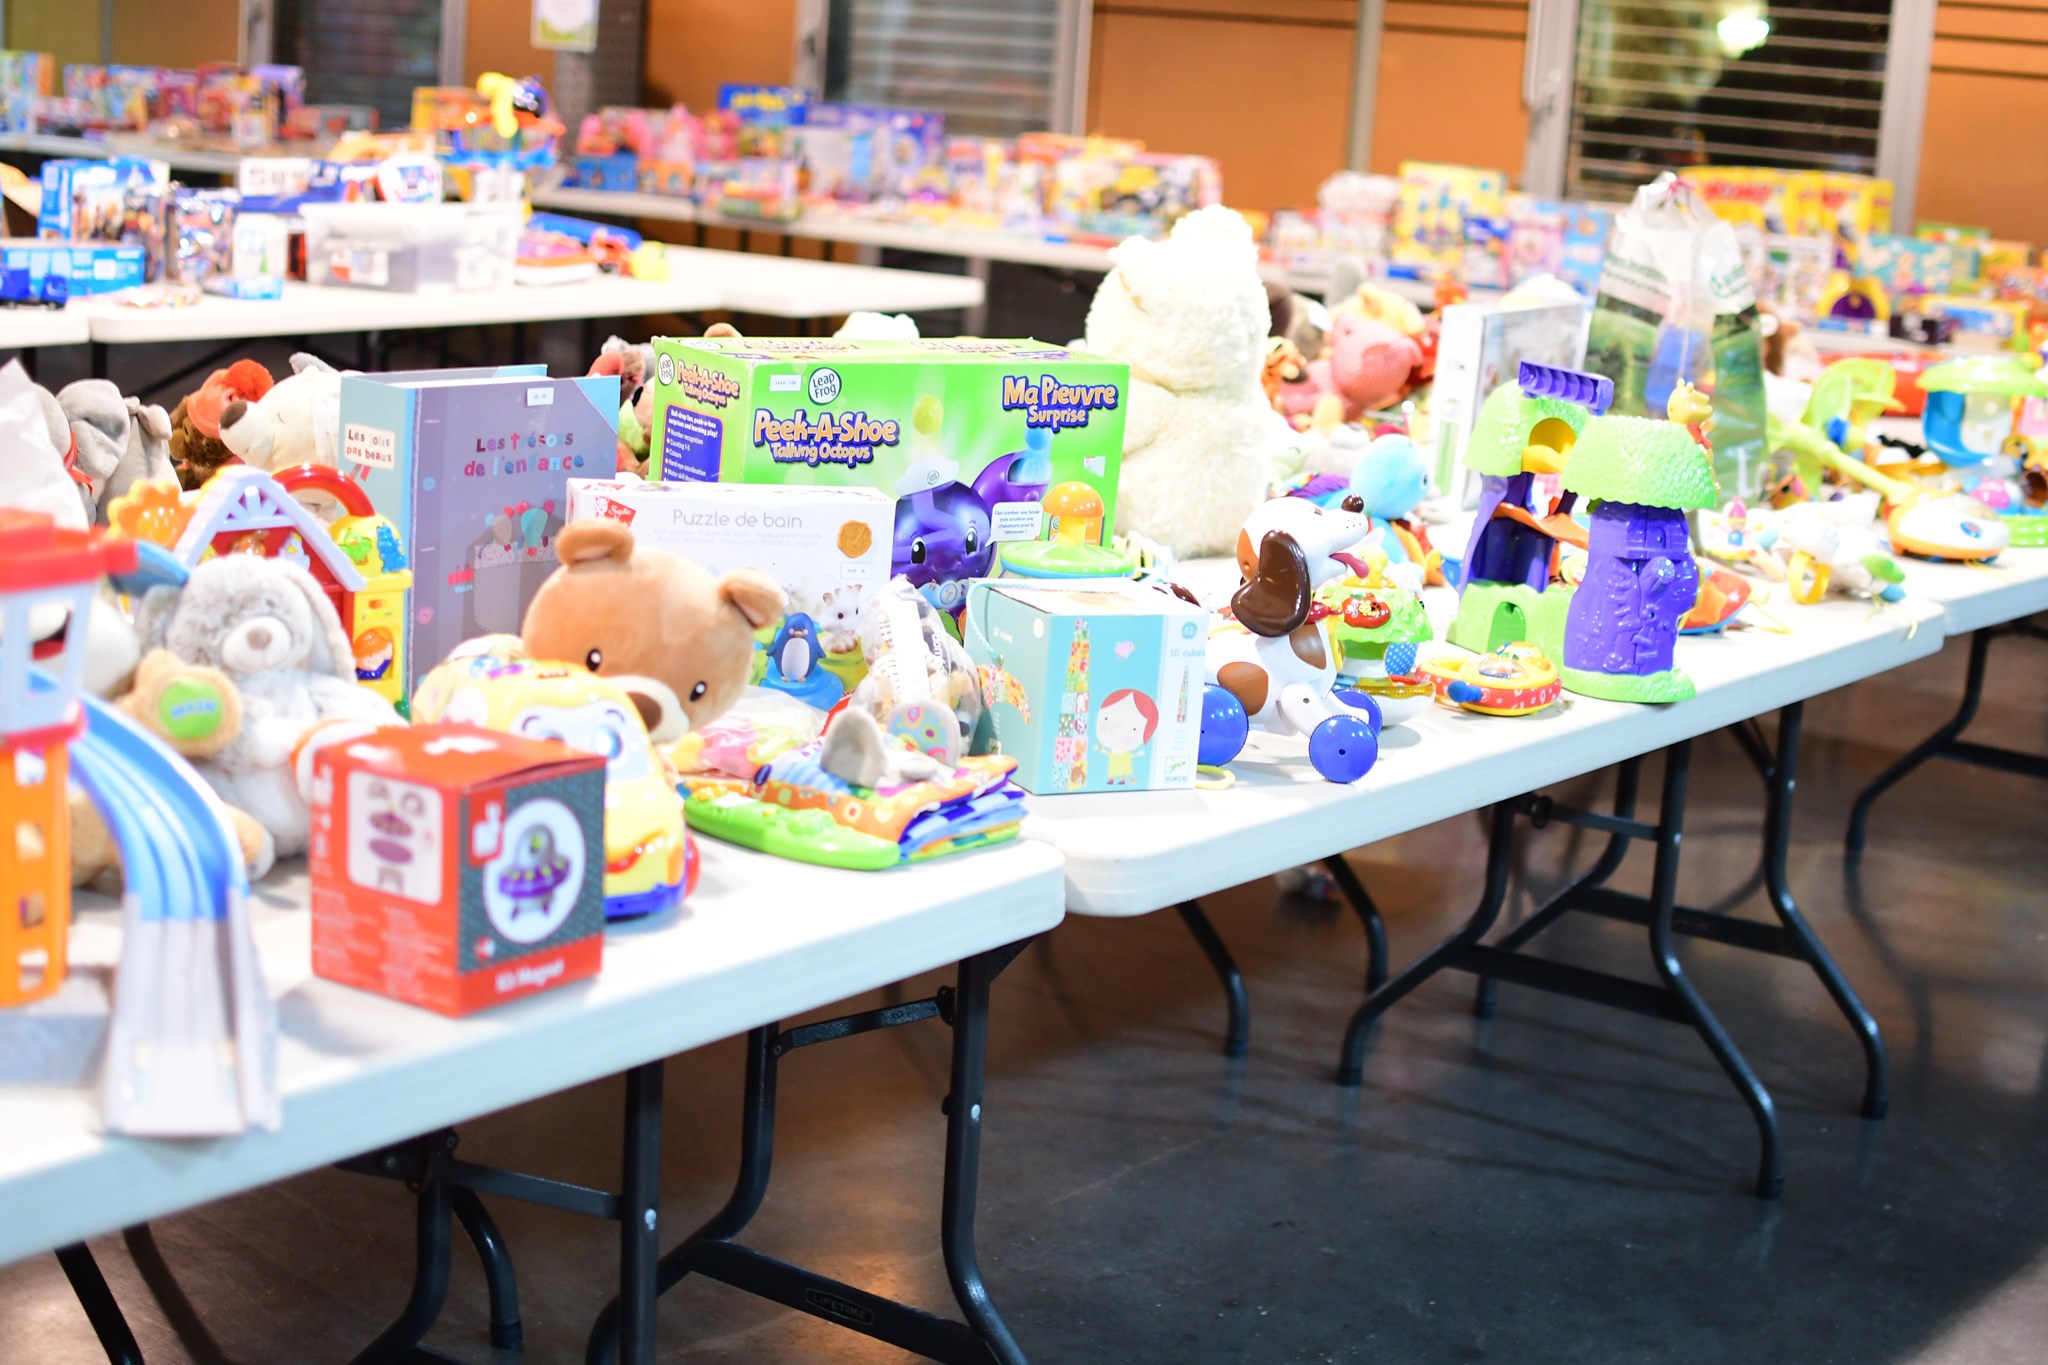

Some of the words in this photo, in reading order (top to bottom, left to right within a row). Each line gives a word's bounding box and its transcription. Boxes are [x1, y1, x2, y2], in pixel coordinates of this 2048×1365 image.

[678, 360, 739, 396] Peek-A-Shoe
[813, 373, 835, 388] Leap
[814, 384, 837, 398] Frog
[1003, 377, 1039, 406] Ma
[1041, 376, 1116, 406] Pieuvre
[754, 409, 898, 444] Peek-A-Shoe
[1028, 406, 1086, 429] Surprise
[348, 429, 365, 442] Les
[476, 438, 505, 453] Les
[510, 431, 574, 450] trésors
[347, 447, 361, 457] pas
[365, 449, 392, 463] beaux
[771, 442, 818, 463] Talking
[819, 442, 870, 463] Octopus
[464, 459, 486, 477] de
[493, 452, 585, 476] l'enfance
[673, 509, 730, 527] Puzzle
[735, 511, 757, 527] de
[763, 512, 802, 529] bain
[1170, 648, 1180, 658] 10
